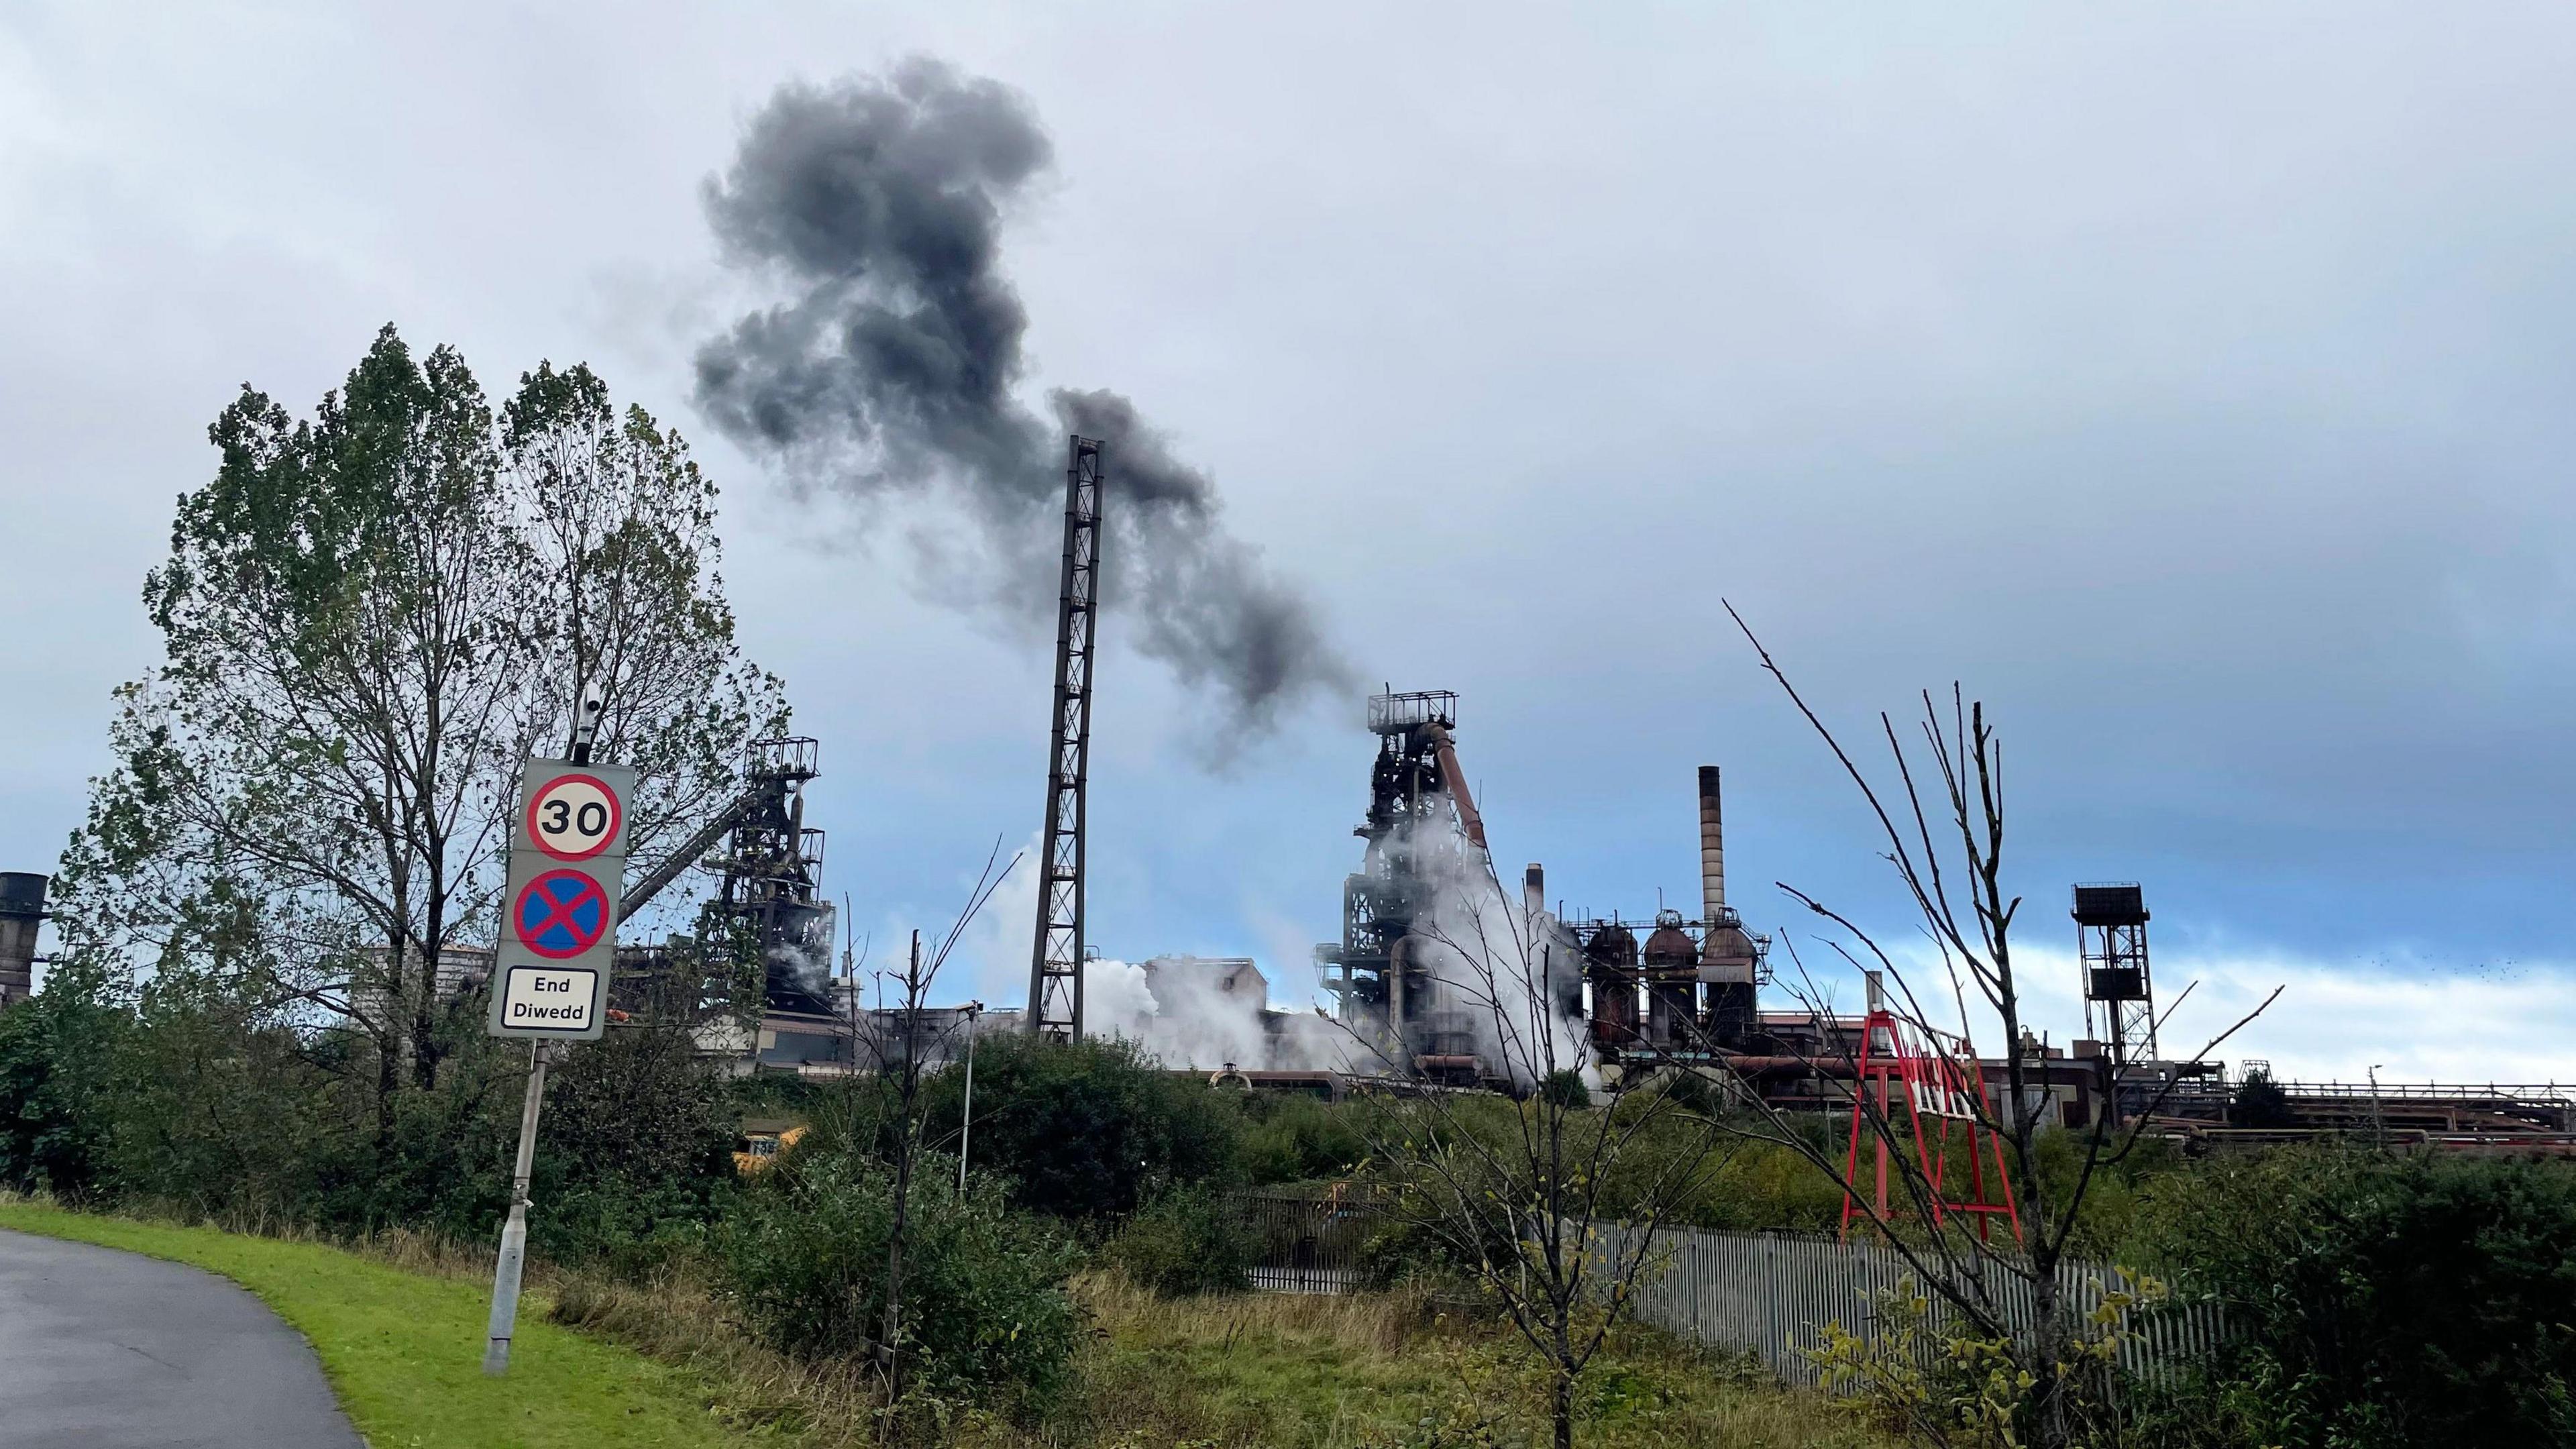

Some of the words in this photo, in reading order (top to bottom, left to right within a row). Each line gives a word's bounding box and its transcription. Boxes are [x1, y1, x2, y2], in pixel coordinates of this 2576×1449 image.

[541, 799, 608, 837] 30
[534, 977, 570, 993] End
[513, 1002, 584, 1020] Diwedd
